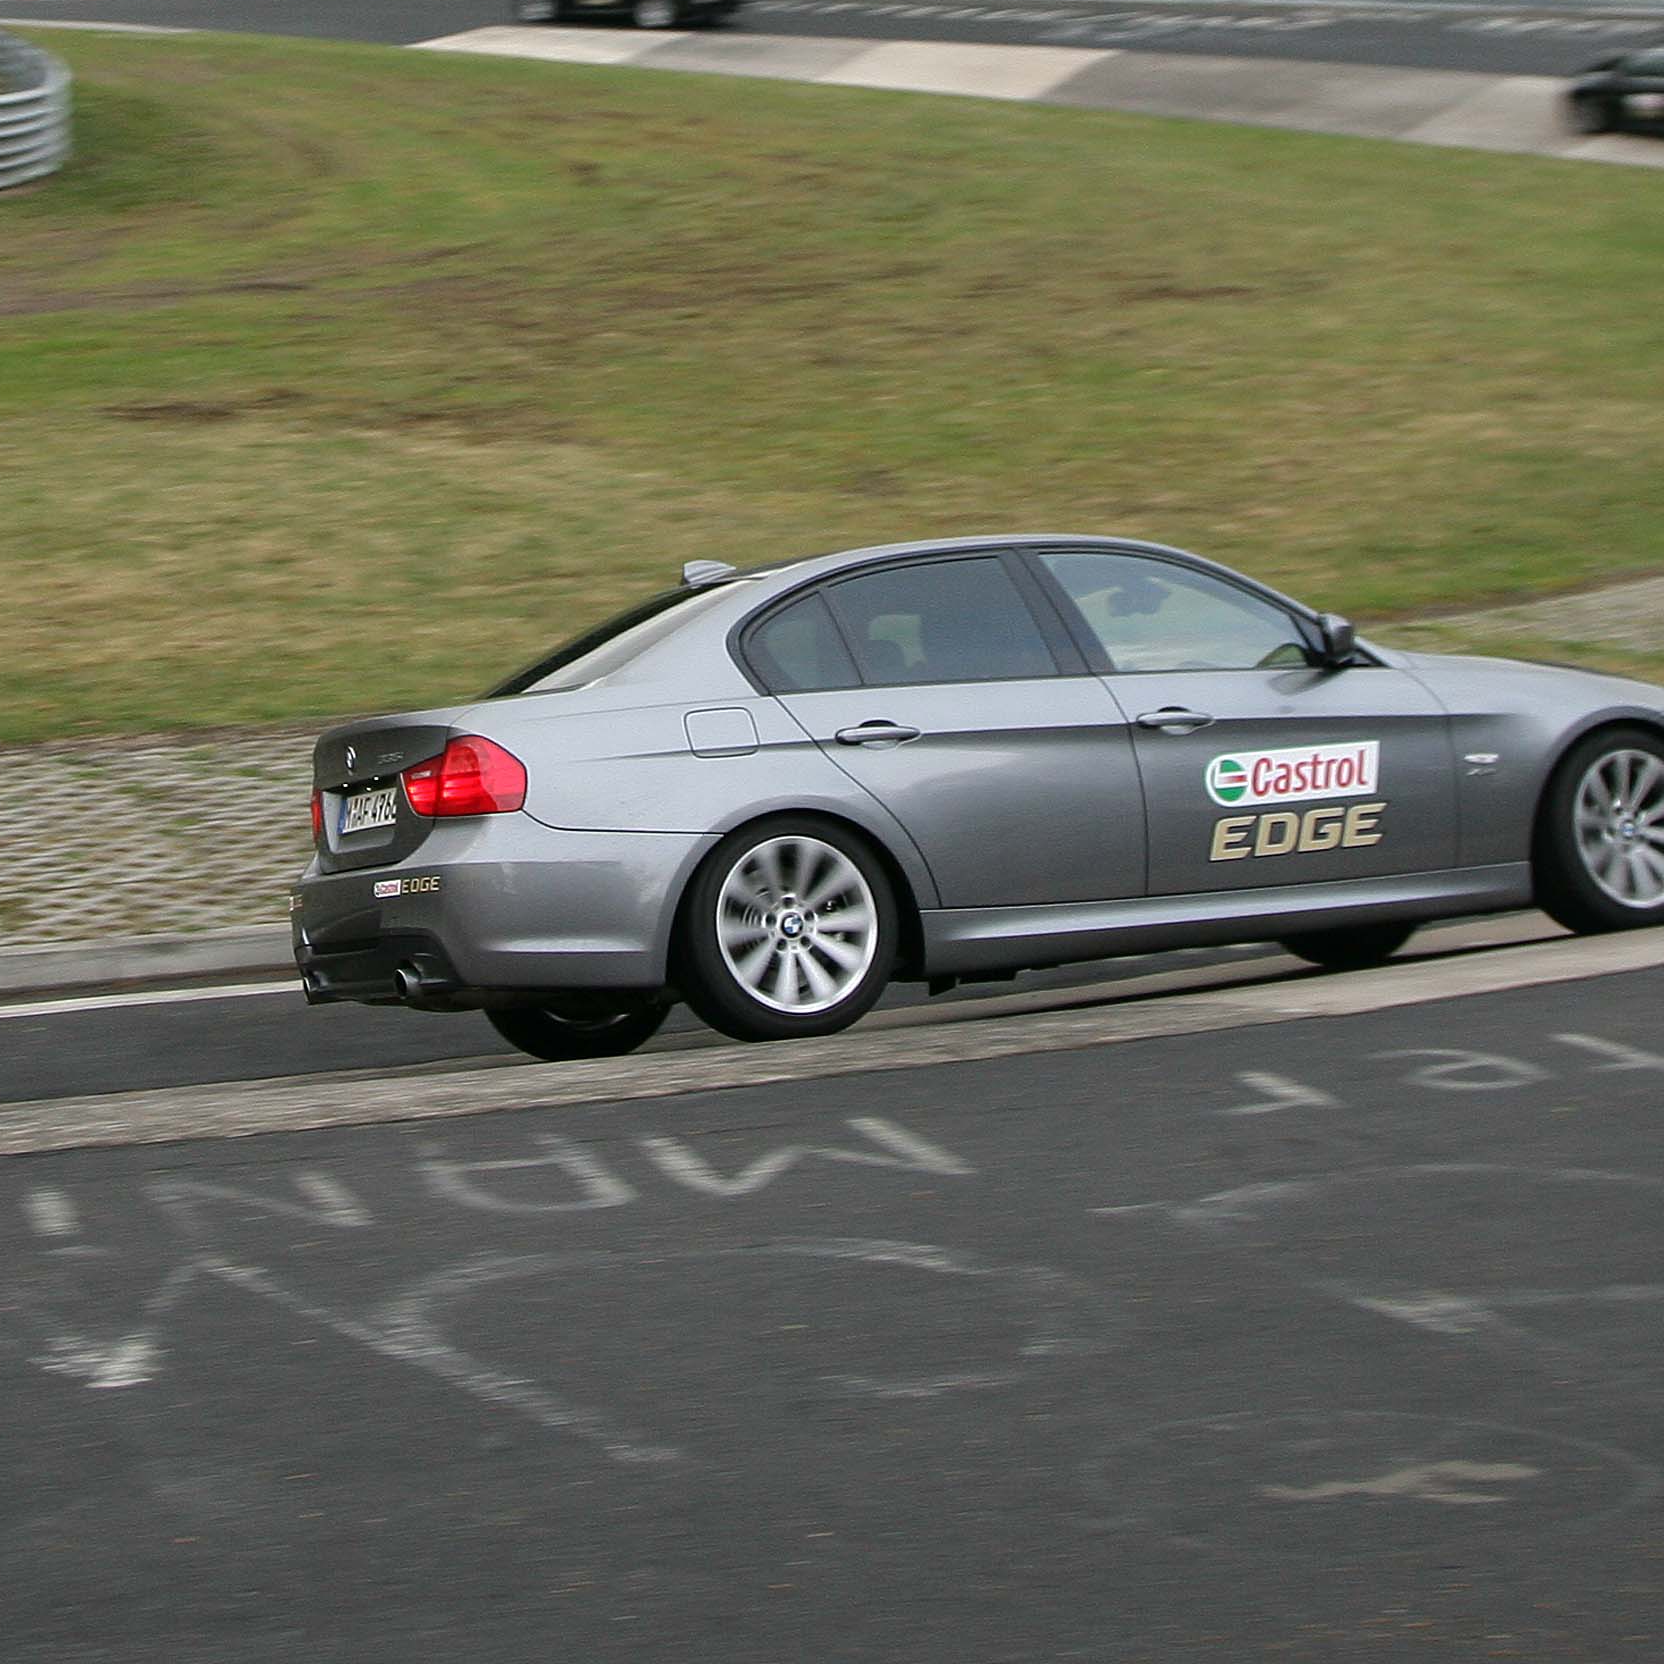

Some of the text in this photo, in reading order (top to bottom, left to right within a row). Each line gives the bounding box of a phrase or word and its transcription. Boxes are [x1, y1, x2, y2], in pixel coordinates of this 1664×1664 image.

[1252, 749, 1369, 797] Castrol
[1209, 802, 1387, 862] EDGE
[402, 876, 441, 894] EDGE
